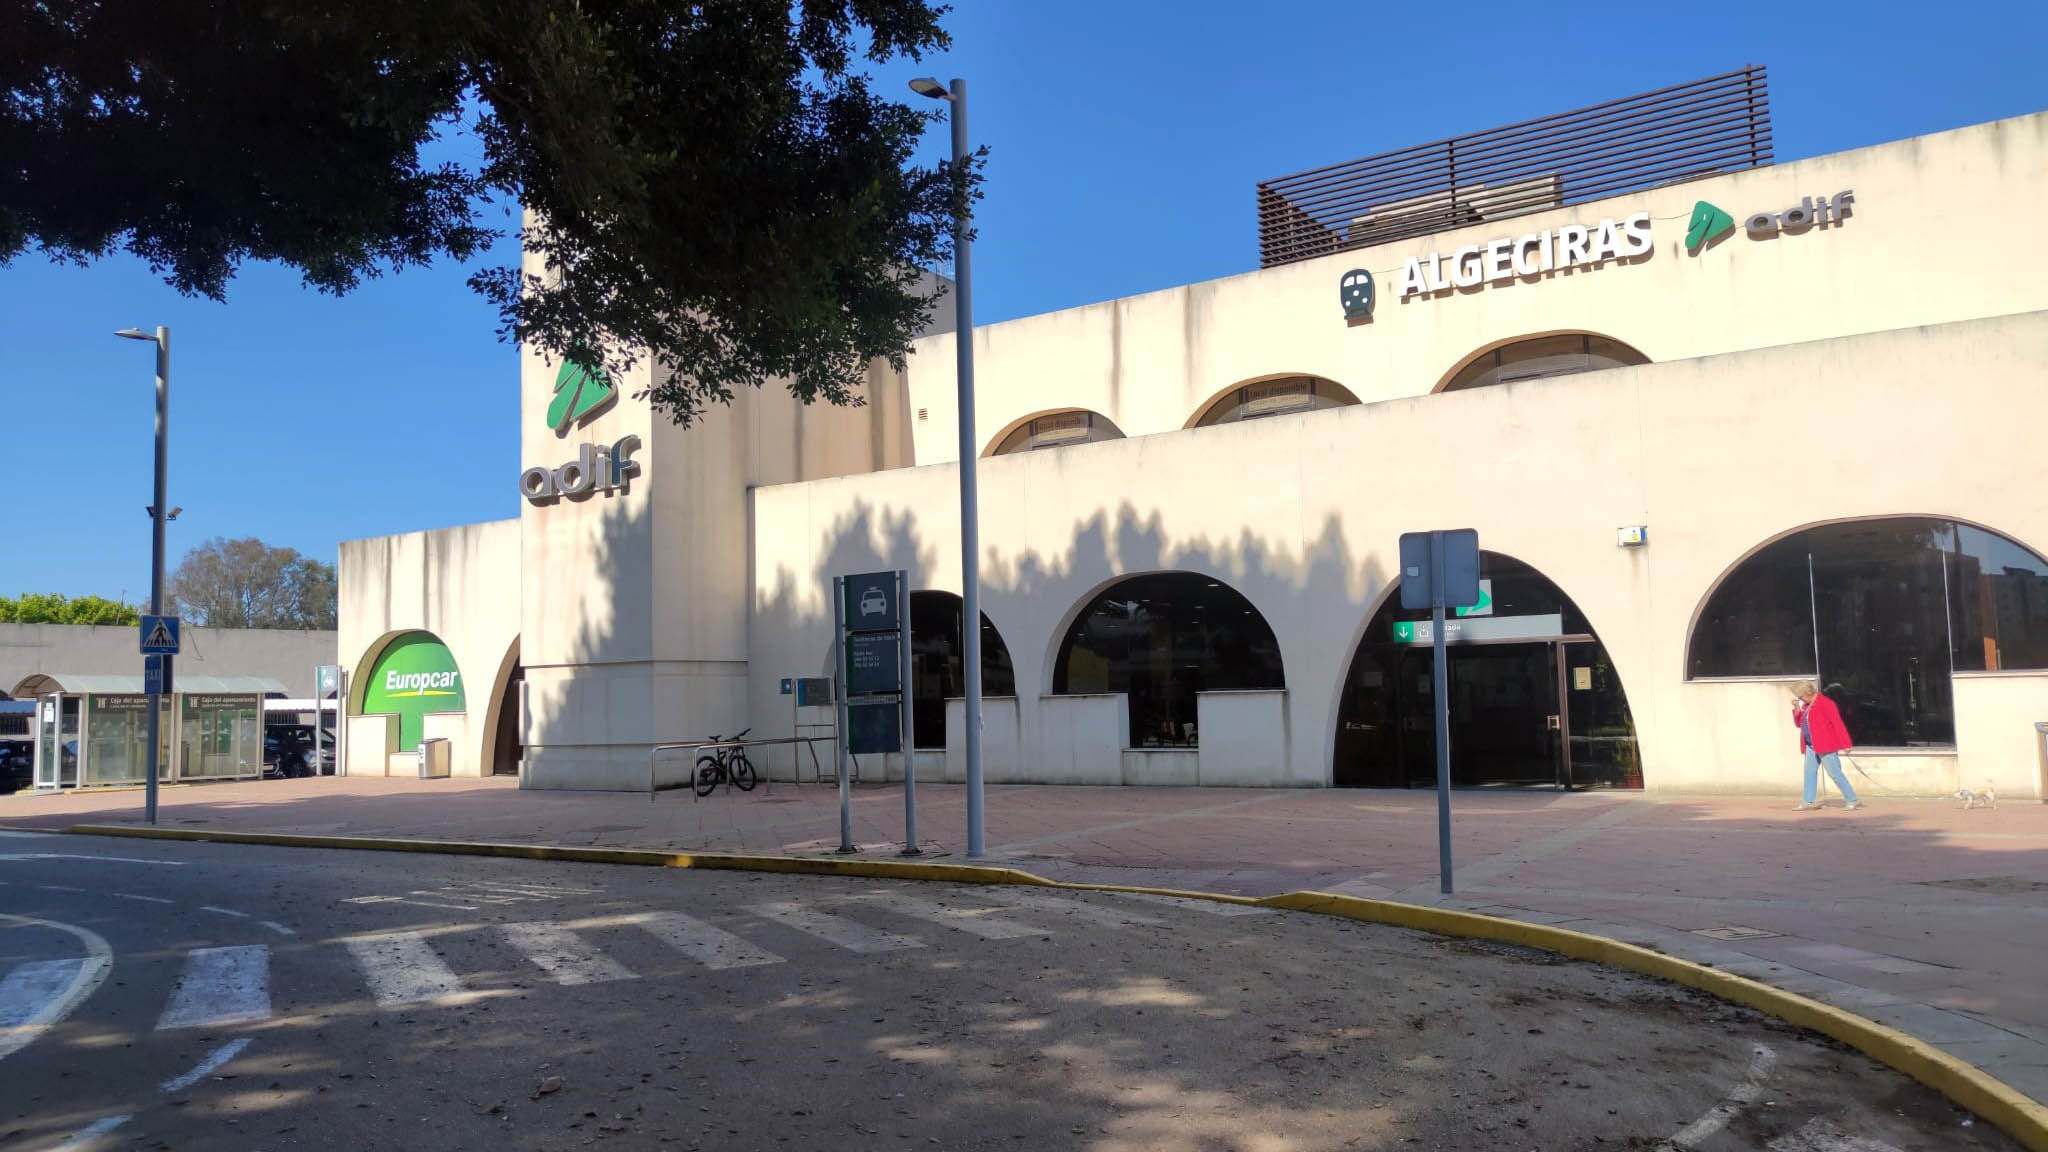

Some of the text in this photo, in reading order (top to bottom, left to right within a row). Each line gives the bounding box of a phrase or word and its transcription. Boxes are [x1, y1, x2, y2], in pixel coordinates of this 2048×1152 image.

[1744, 189, 1854, 235] adif
[1400, 211, 1653, 297] ALGECIRAS
[519, 434, 641, 499] adif
[385, 669, 458, 696] Europcar
